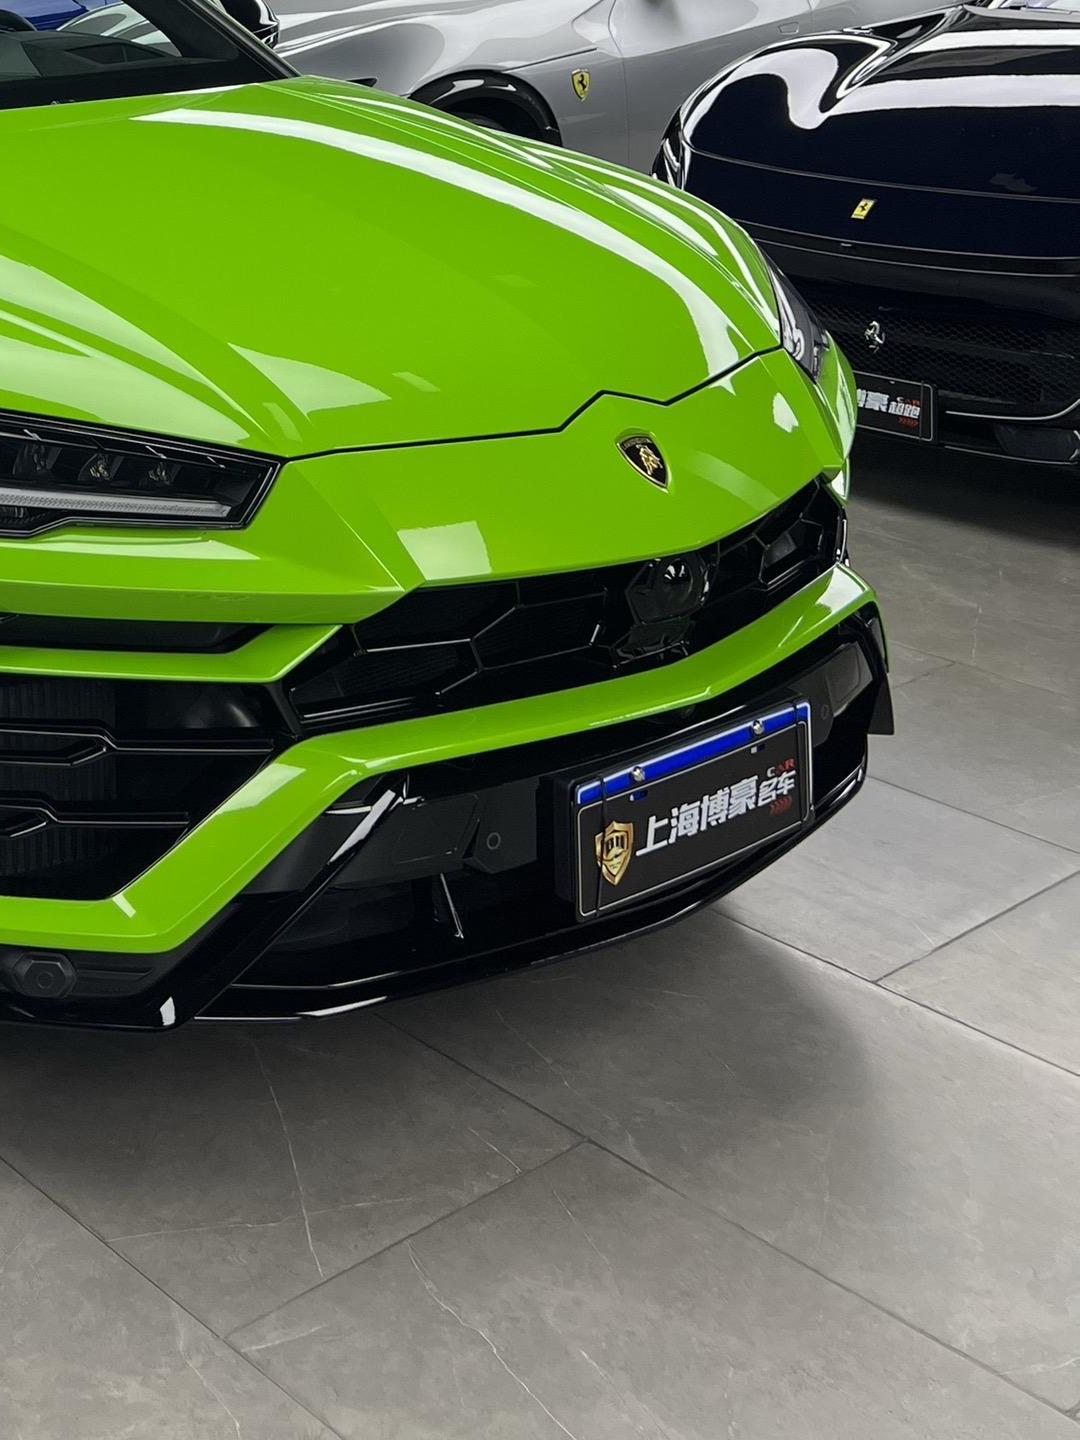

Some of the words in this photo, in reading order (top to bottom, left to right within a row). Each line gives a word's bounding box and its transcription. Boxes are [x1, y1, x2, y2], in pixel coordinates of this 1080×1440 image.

[635, 770, 796, 856] 上海博豪名车
